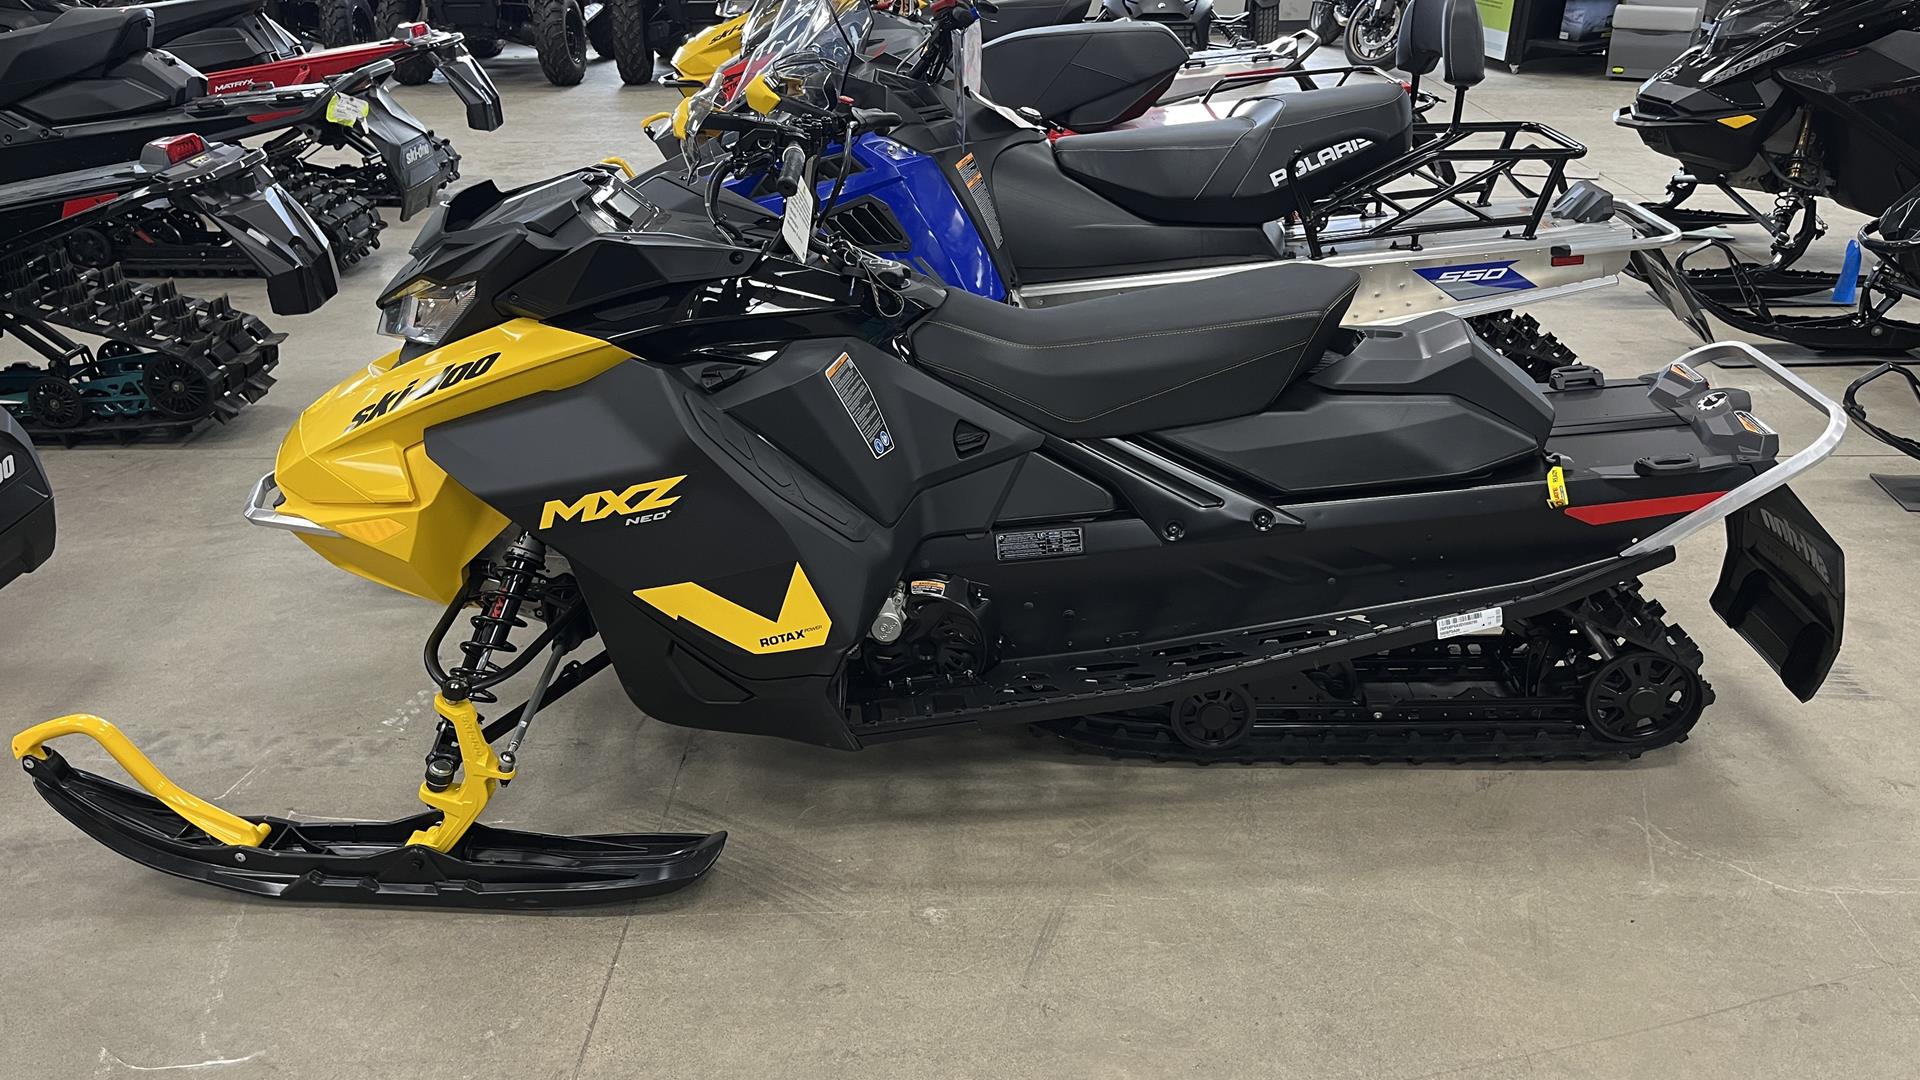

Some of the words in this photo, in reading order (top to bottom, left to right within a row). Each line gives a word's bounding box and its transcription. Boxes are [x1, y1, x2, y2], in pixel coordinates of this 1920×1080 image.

[214, 78, 256, 93] MATRYX
[1269, 138, 1374, 188] POLARIS
[1435, 267, 1509, 284] 550
[538, 474, 688, 530] MXZ
[759, 629, 805, 648] ROTAX
[803, 624, 823, 633] POWER
